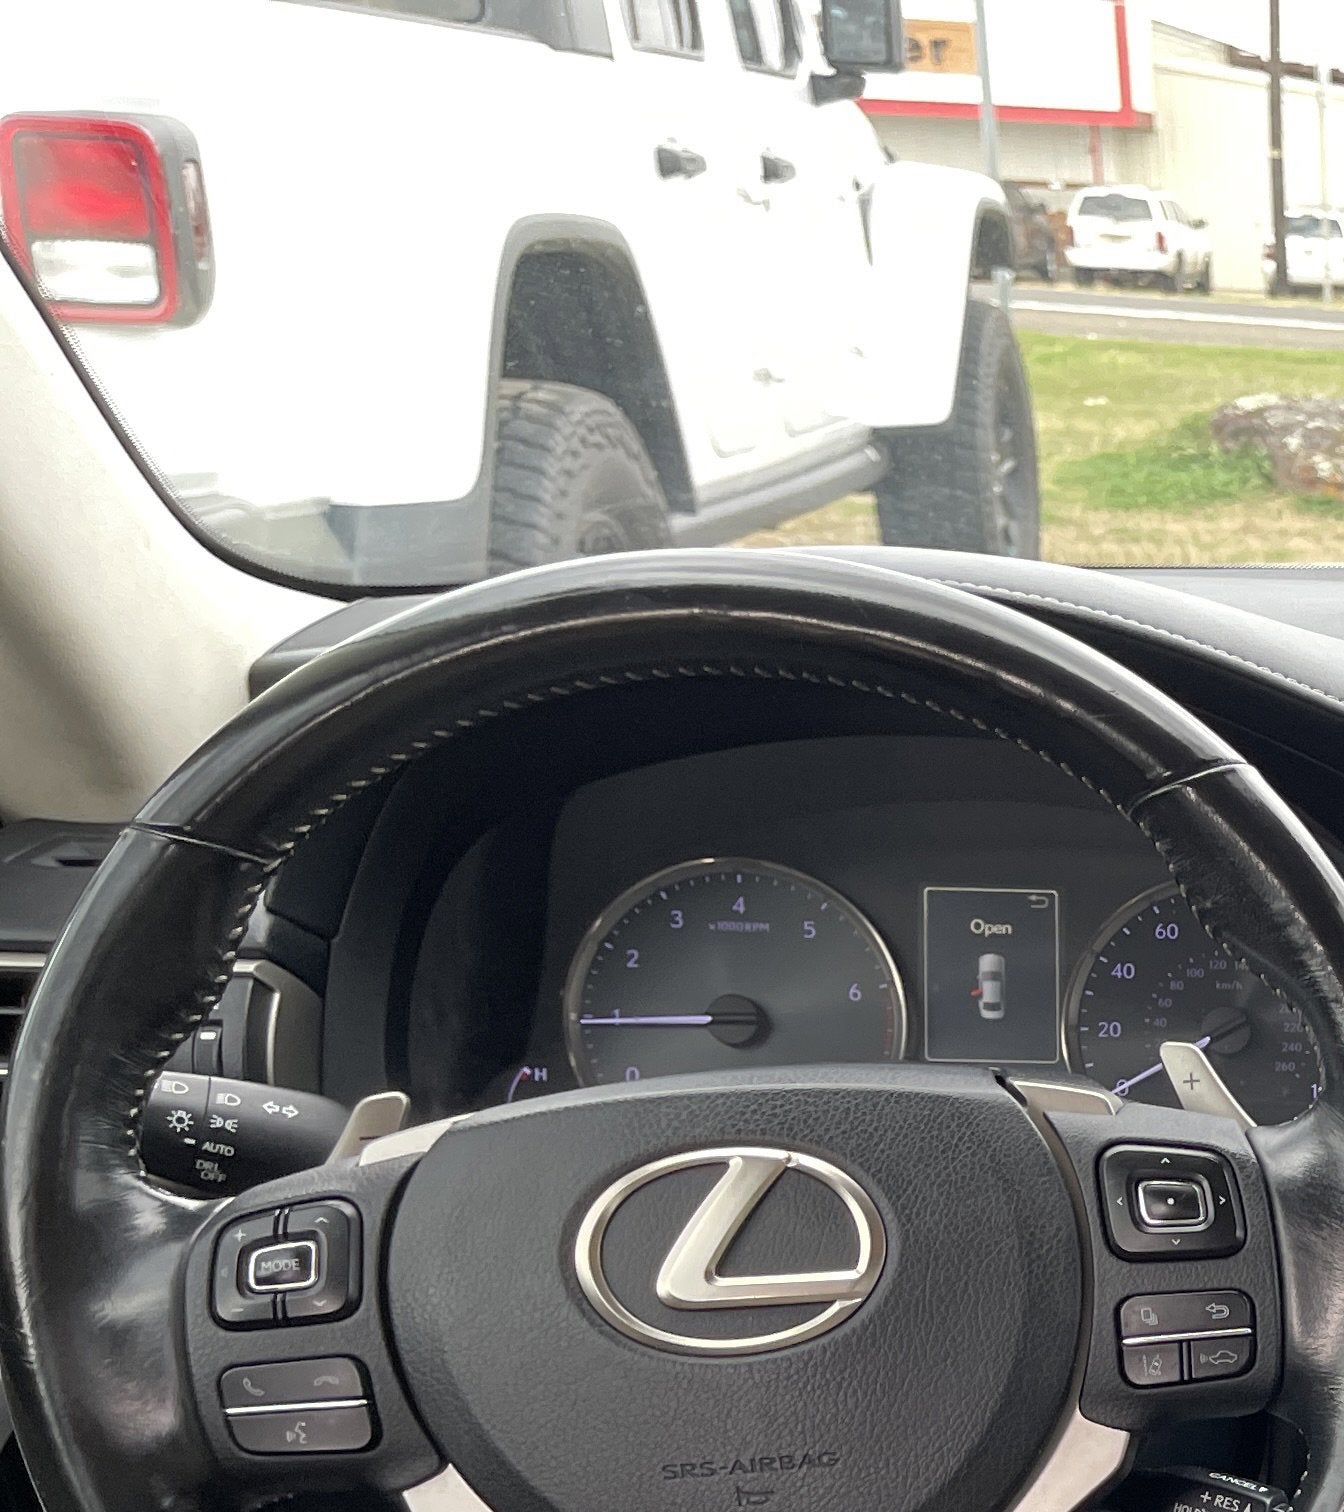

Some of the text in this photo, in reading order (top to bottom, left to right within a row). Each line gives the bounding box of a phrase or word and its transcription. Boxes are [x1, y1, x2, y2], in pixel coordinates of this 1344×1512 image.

[732, 896, 746, 914] 4
[670, 910, 684, 929] 3
[970, 918, 1012, 936] Open
[803, 921, 816, 939] 5
[1155, 923, 1179, 940] 60
[626, 950, 640, 968] 2
[1209, 960, 1227, 970] 120
[1111, 963, 1136, 979] 40
[1186, 968, 1205, 978] 100
[848, 984, 862, 1001] 6
[1098, 1022, 1121, 1038] 20
[534, 1067, 548, 1082] H
[202, 1141, 235, 1157] AUTO
[260, 1257, 300, 1273] MODE
[660, 1451, 842, 1481] SRS-AIRBAG
[1208, 1472, 1258, 1491] CANCEL
[1213, 1494, 1241, 1512] RES
